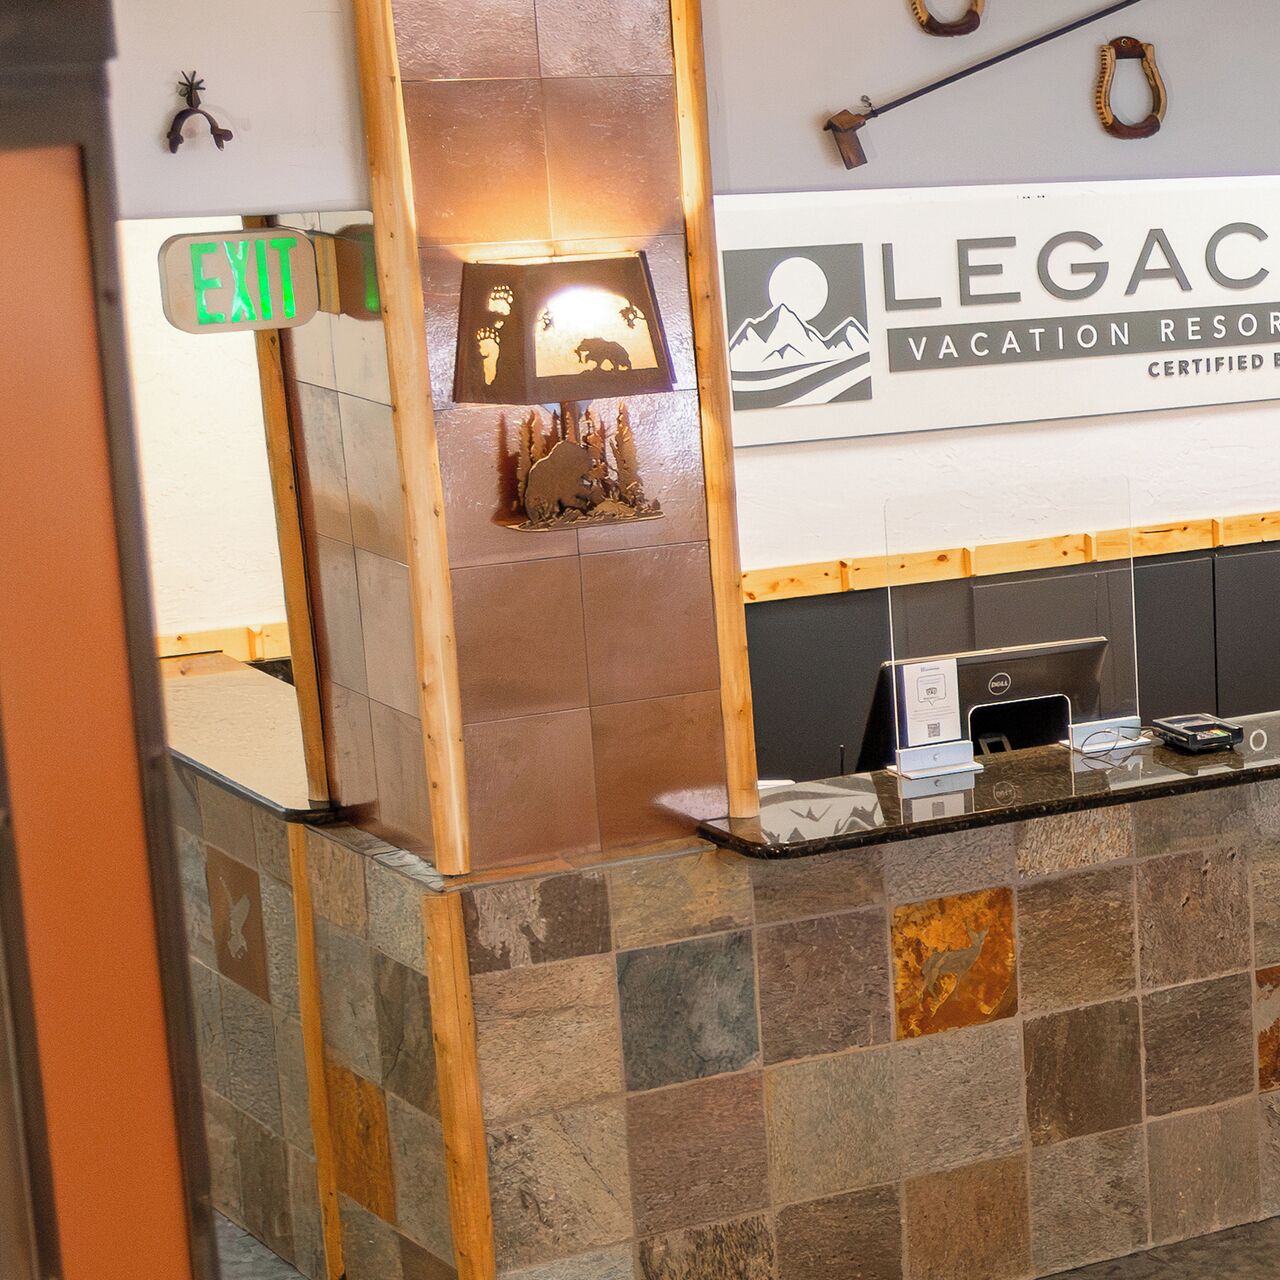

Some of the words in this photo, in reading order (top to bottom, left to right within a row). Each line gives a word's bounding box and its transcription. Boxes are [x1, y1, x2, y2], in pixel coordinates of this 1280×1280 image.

[189, 237, 297, 325] EXIT
[908, 321, 1130, 361] VACATION
[1148, 353, 1264, 378] CERTIFIED
[991, 680, 1008, 688] DELL
